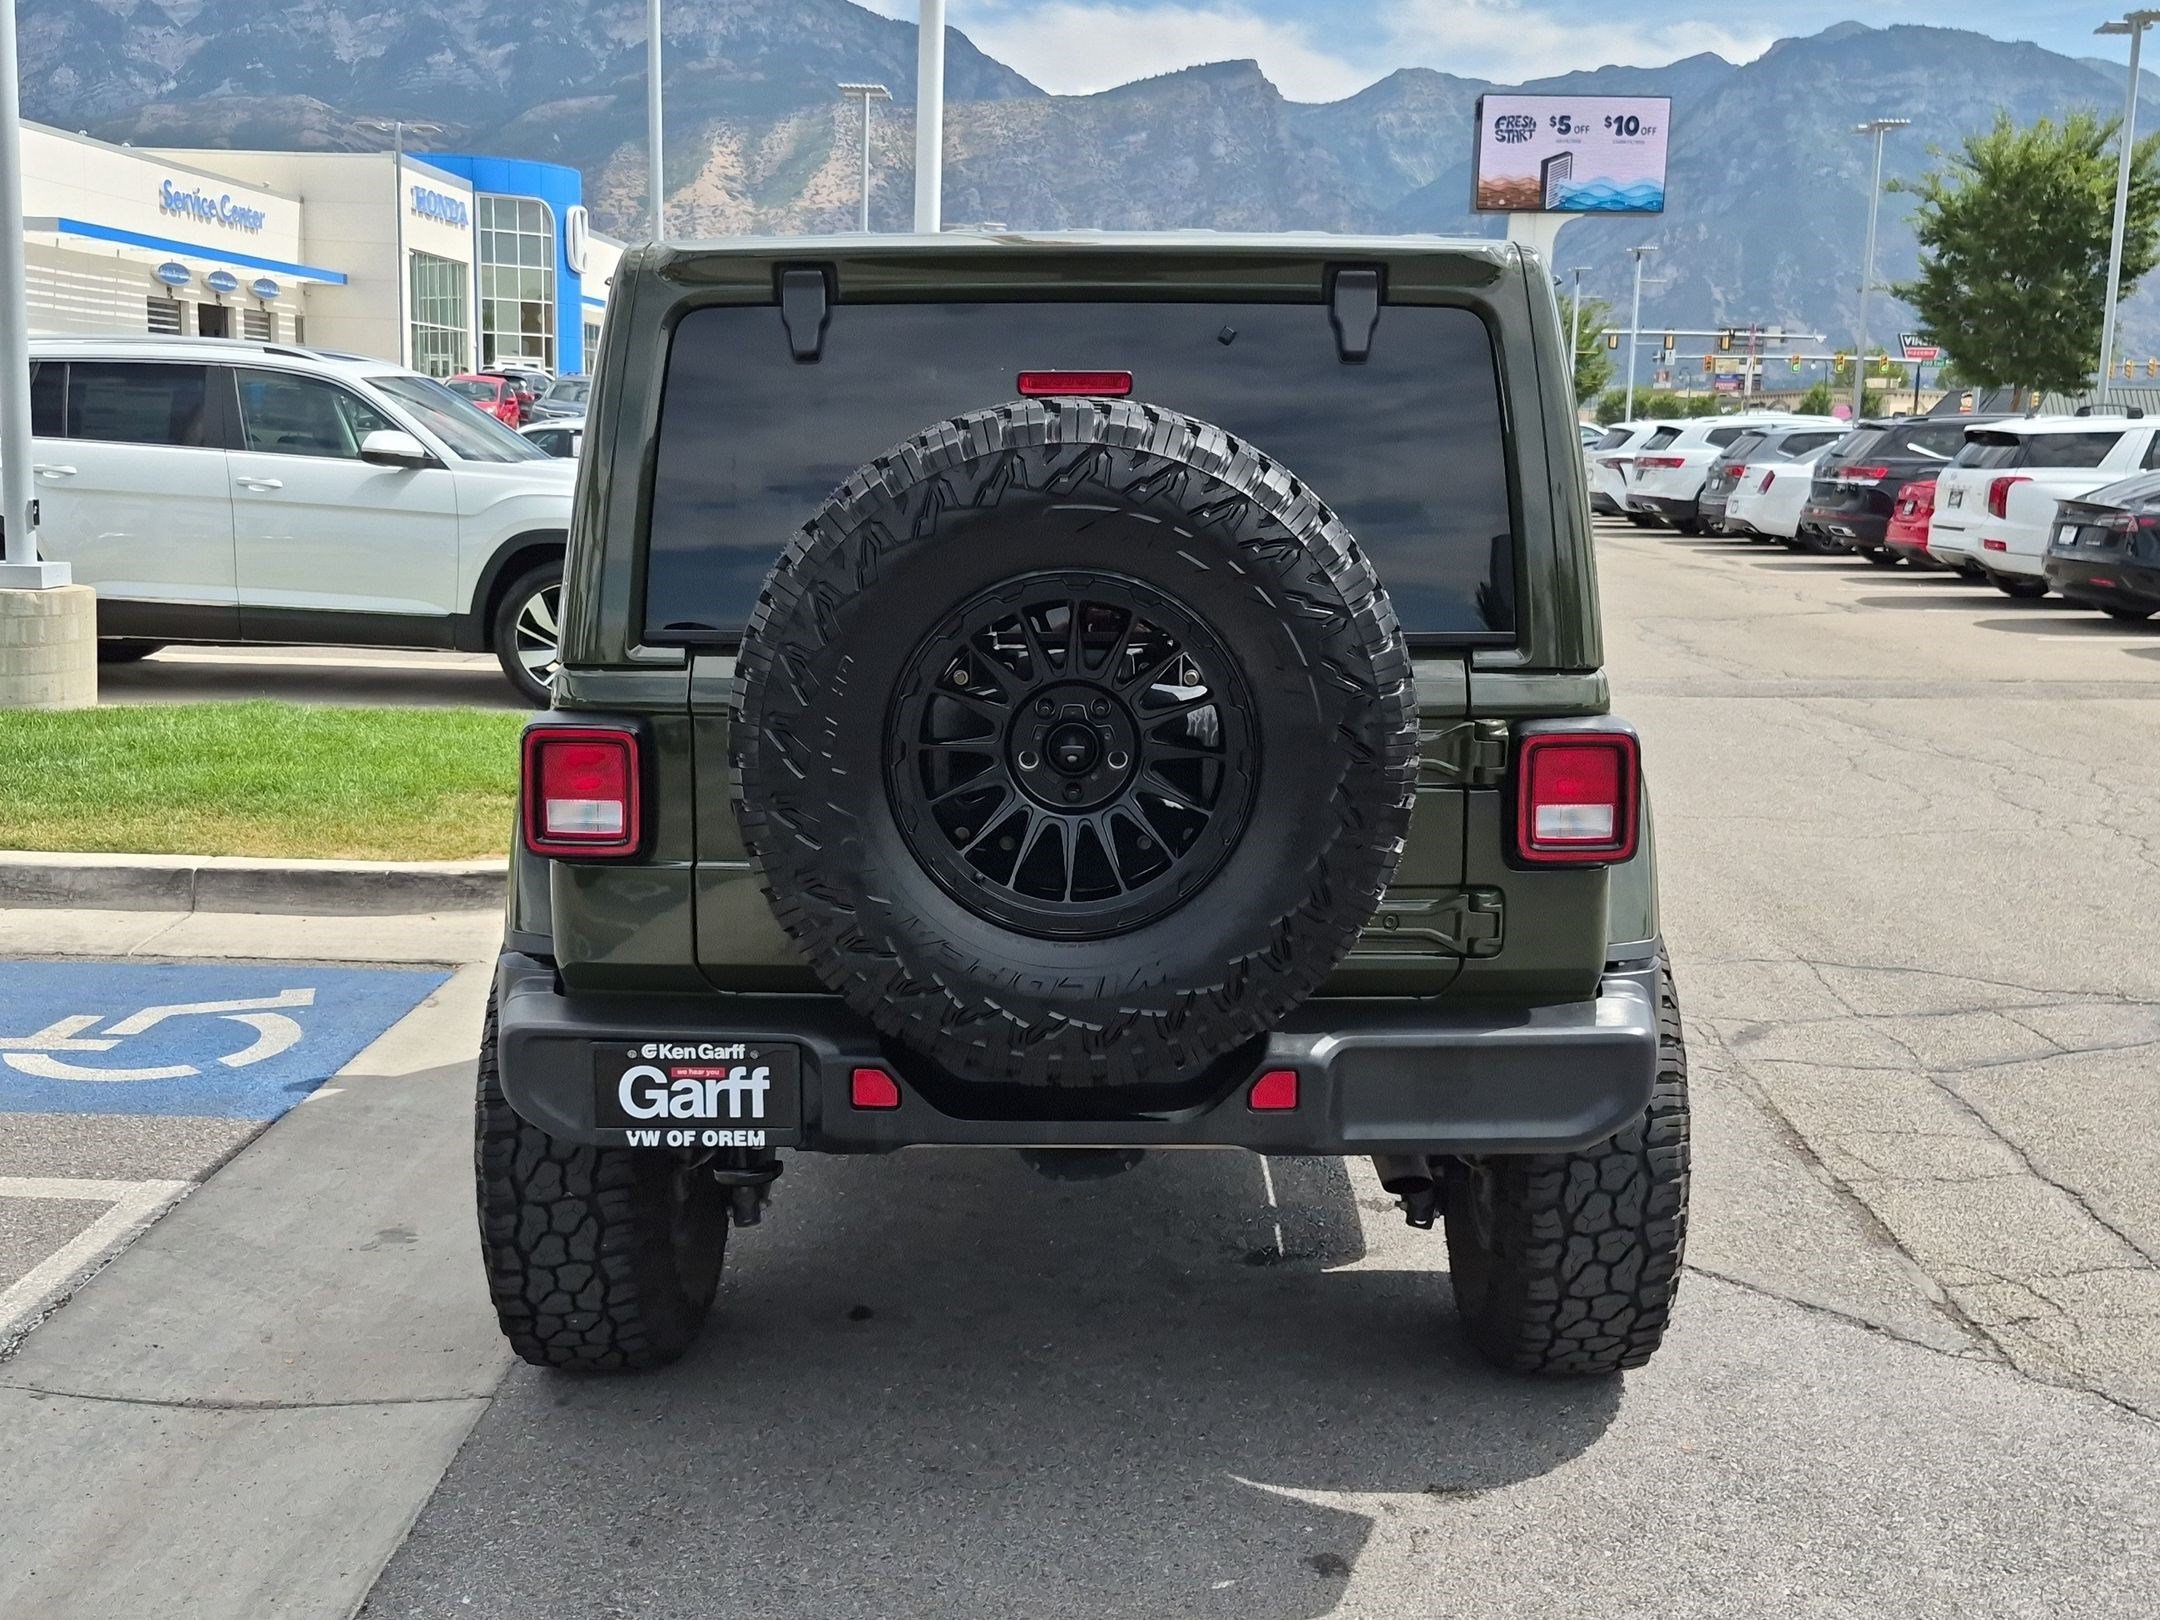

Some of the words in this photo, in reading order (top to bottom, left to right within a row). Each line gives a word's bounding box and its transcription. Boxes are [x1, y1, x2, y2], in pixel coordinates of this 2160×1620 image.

[1494, 115, 1537, 130] FRESH
[1549, 115, 1571, 136] $5
[1574, 126, 1590, 135] OFF
[1604, 115, 1640, 137] $10
[1641, 126, 1657, 136] OFF
[1495, 128, 1536, 144] START
[163, 179, 217, 218] Service
[220, 194, 265, 230] Center
[410, 185, 469, 226] HONDA
[659, 1044, 696, 1060] Ken
[698, 1044, 746, 1060] Garff
[618, 1065, 771, 1119] Garff
[626, 1130, 661, 1147] VW
[666, 1130, 697, 1147] OF
[701, 1130, 766, 1147] OREM
